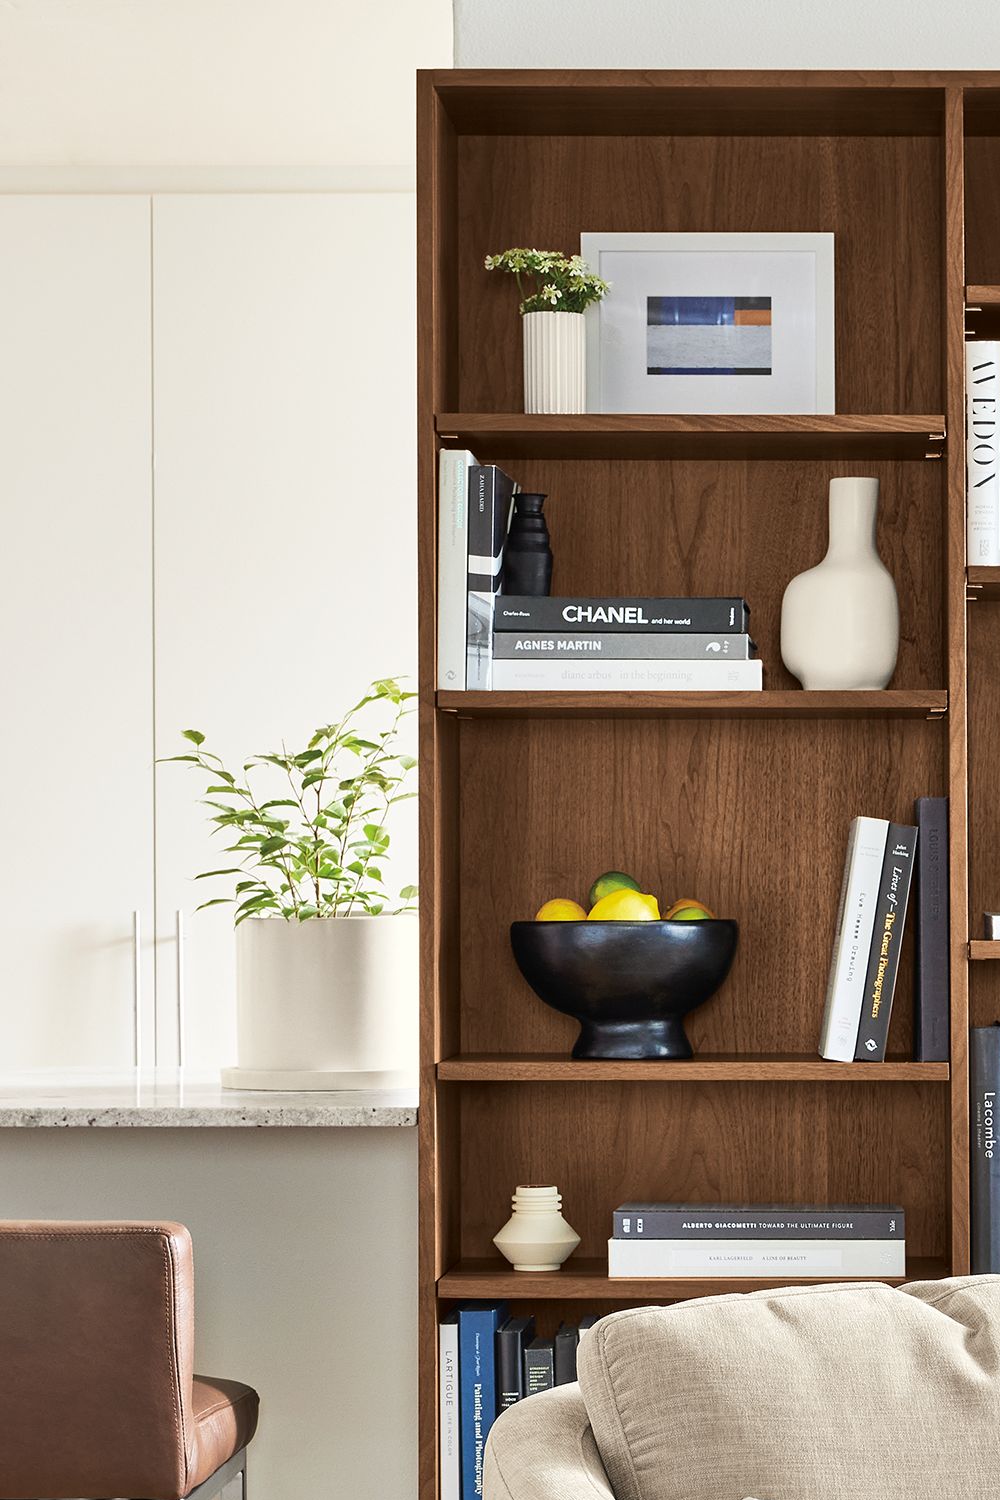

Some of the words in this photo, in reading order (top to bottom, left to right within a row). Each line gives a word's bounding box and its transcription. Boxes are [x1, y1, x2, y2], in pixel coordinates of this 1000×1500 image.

[561, 605, 649, 625] CHANEL
[651, 617, 663, 625] and
[663, 617, 673, 625] her
[673, 617, 691, 626] world
[514, 639, 555, 651] AGNES
[557, 639, 602, 651] MARTIN
[560, 669, 586, 680] diane
[587, 669, 612, 680] arbus
[619, 669, 629, 680] in
[630, 669, 646, 680] the
[647, 669, 693, 682] beginning
[890, 866, 903, 891] Lives
[858, 892, 866, 907] Eva
[853, 913, 863, 939] Hesse
[884, 912, 897, 930] The
[880, 930, 893, 955] Great
[846, 945, 859, 982] Drawing
[871, 957, 889, 1019] Photographers
[984, 1091, 997, 1159] Lacombe
[445, 1350, 454, 1407] LARTIGUE
[473, 1383, 483, 1422] Painting
[447, 1426, 452, 1434] IN
[473, 1422, 483, 1439] and
[473, 1440, 483, 1496] Photography
